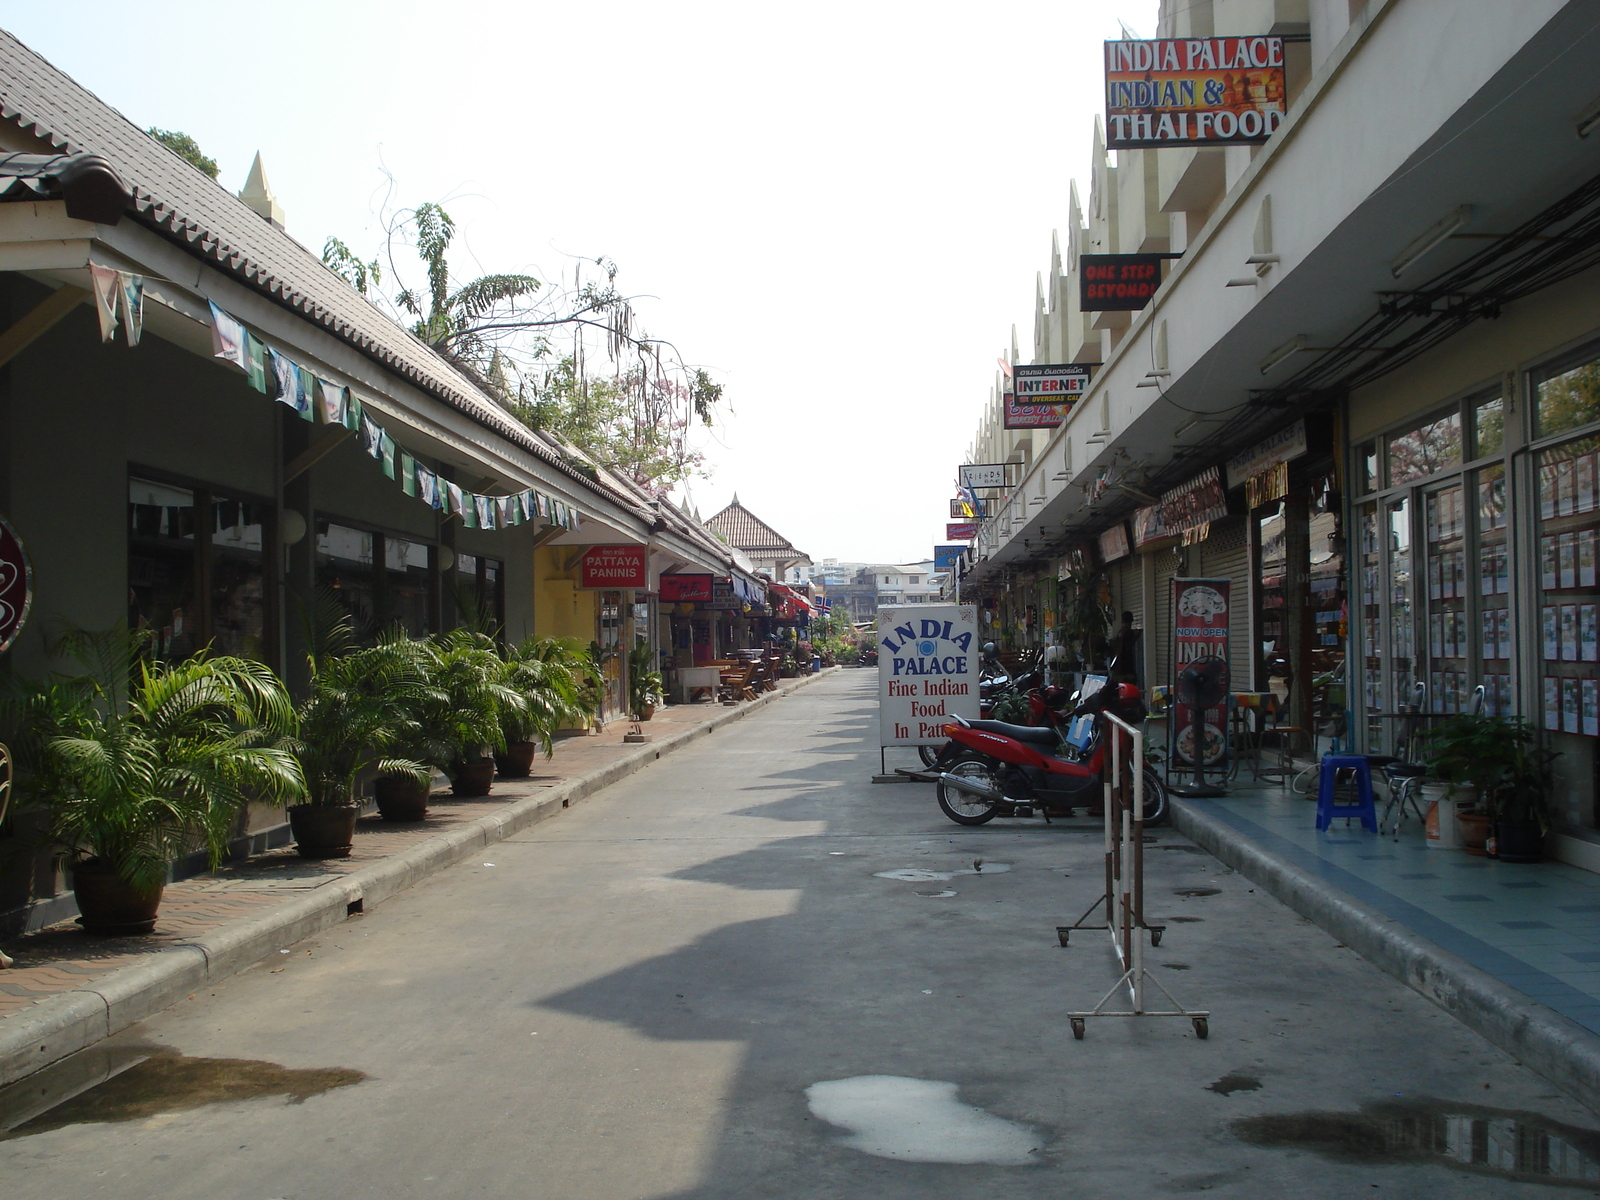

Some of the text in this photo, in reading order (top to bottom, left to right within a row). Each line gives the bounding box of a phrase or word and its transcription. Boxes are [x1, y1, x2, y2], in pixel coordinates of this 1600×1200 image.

[1109, 37, 1284, 72] INDIA PALACE
[1109, 78, 1226, 109] INDIAN &
[1109, 109, 1286, 141] THAI FOOD
[1085, 264, 1155, 280] ONE STEP
[1087, 283, 1156, 299] BEYOND!
[1018, 378, 1086, 392] INTERNET
[1232, 449, 1256, 470] INDIA
[1260, 424, 1296, 454] PALACE
[586, 556, 640, 566] PATTAYA
[590, 568, 637, 578] PANINIS
[881, 619, 973, 655] INDIA
[1177, 628, 1228, 638] NOW OPEN
[1178, 641, 1227, 665] INDIA
[892, 656, 968, 676] PALACE
[888, 678, 969, 697] Fine Indian
[911, 698, 946, 717] Food
[894, 722, 909, 739] In
